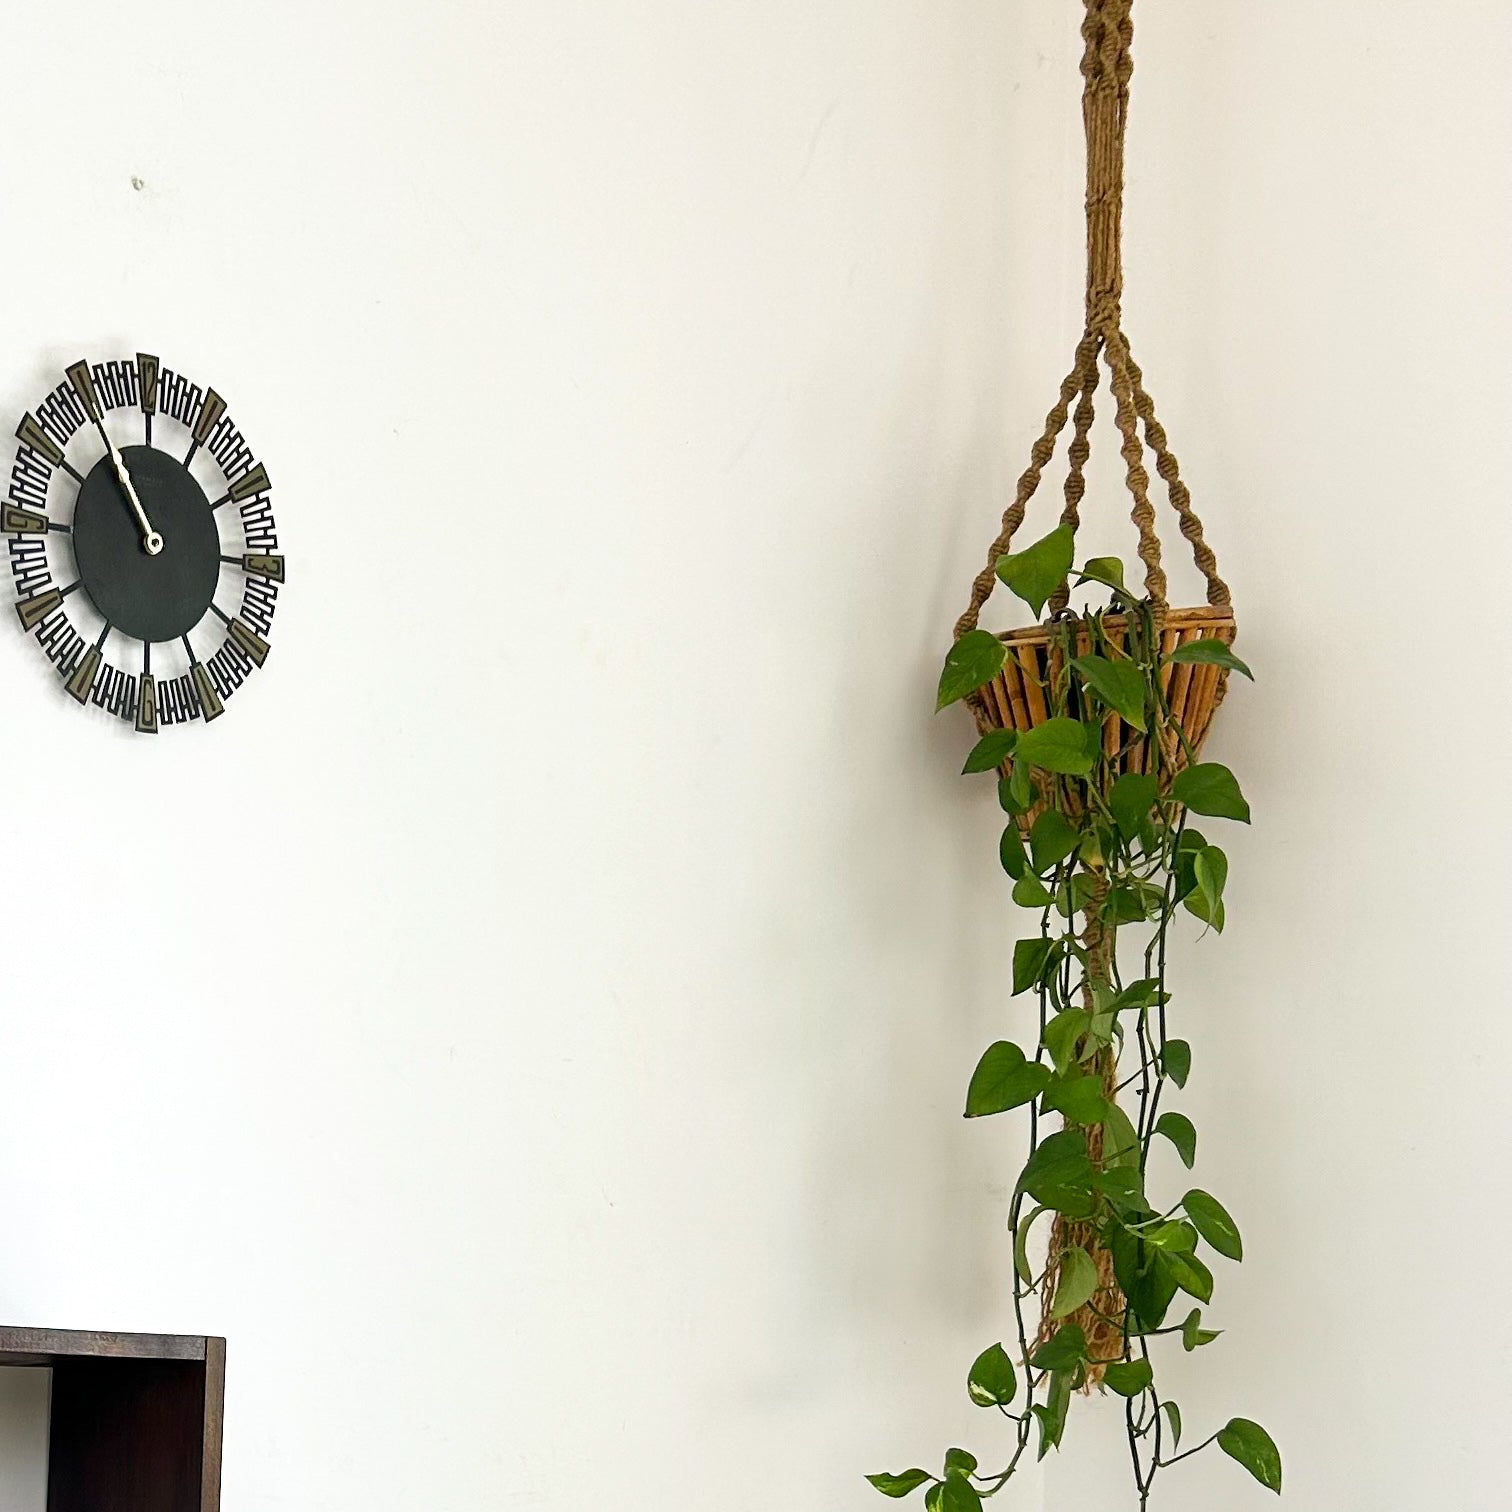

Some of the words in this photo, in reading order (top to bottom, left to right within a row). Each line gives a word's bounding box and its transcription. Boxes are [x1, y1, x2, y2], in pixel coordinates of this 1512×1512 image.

[142, 361, 156, 409] 12
[7, 510, 44, 530] 9
[248, 558, 281, 575] 3
[142, 679, 154, 726] 6
